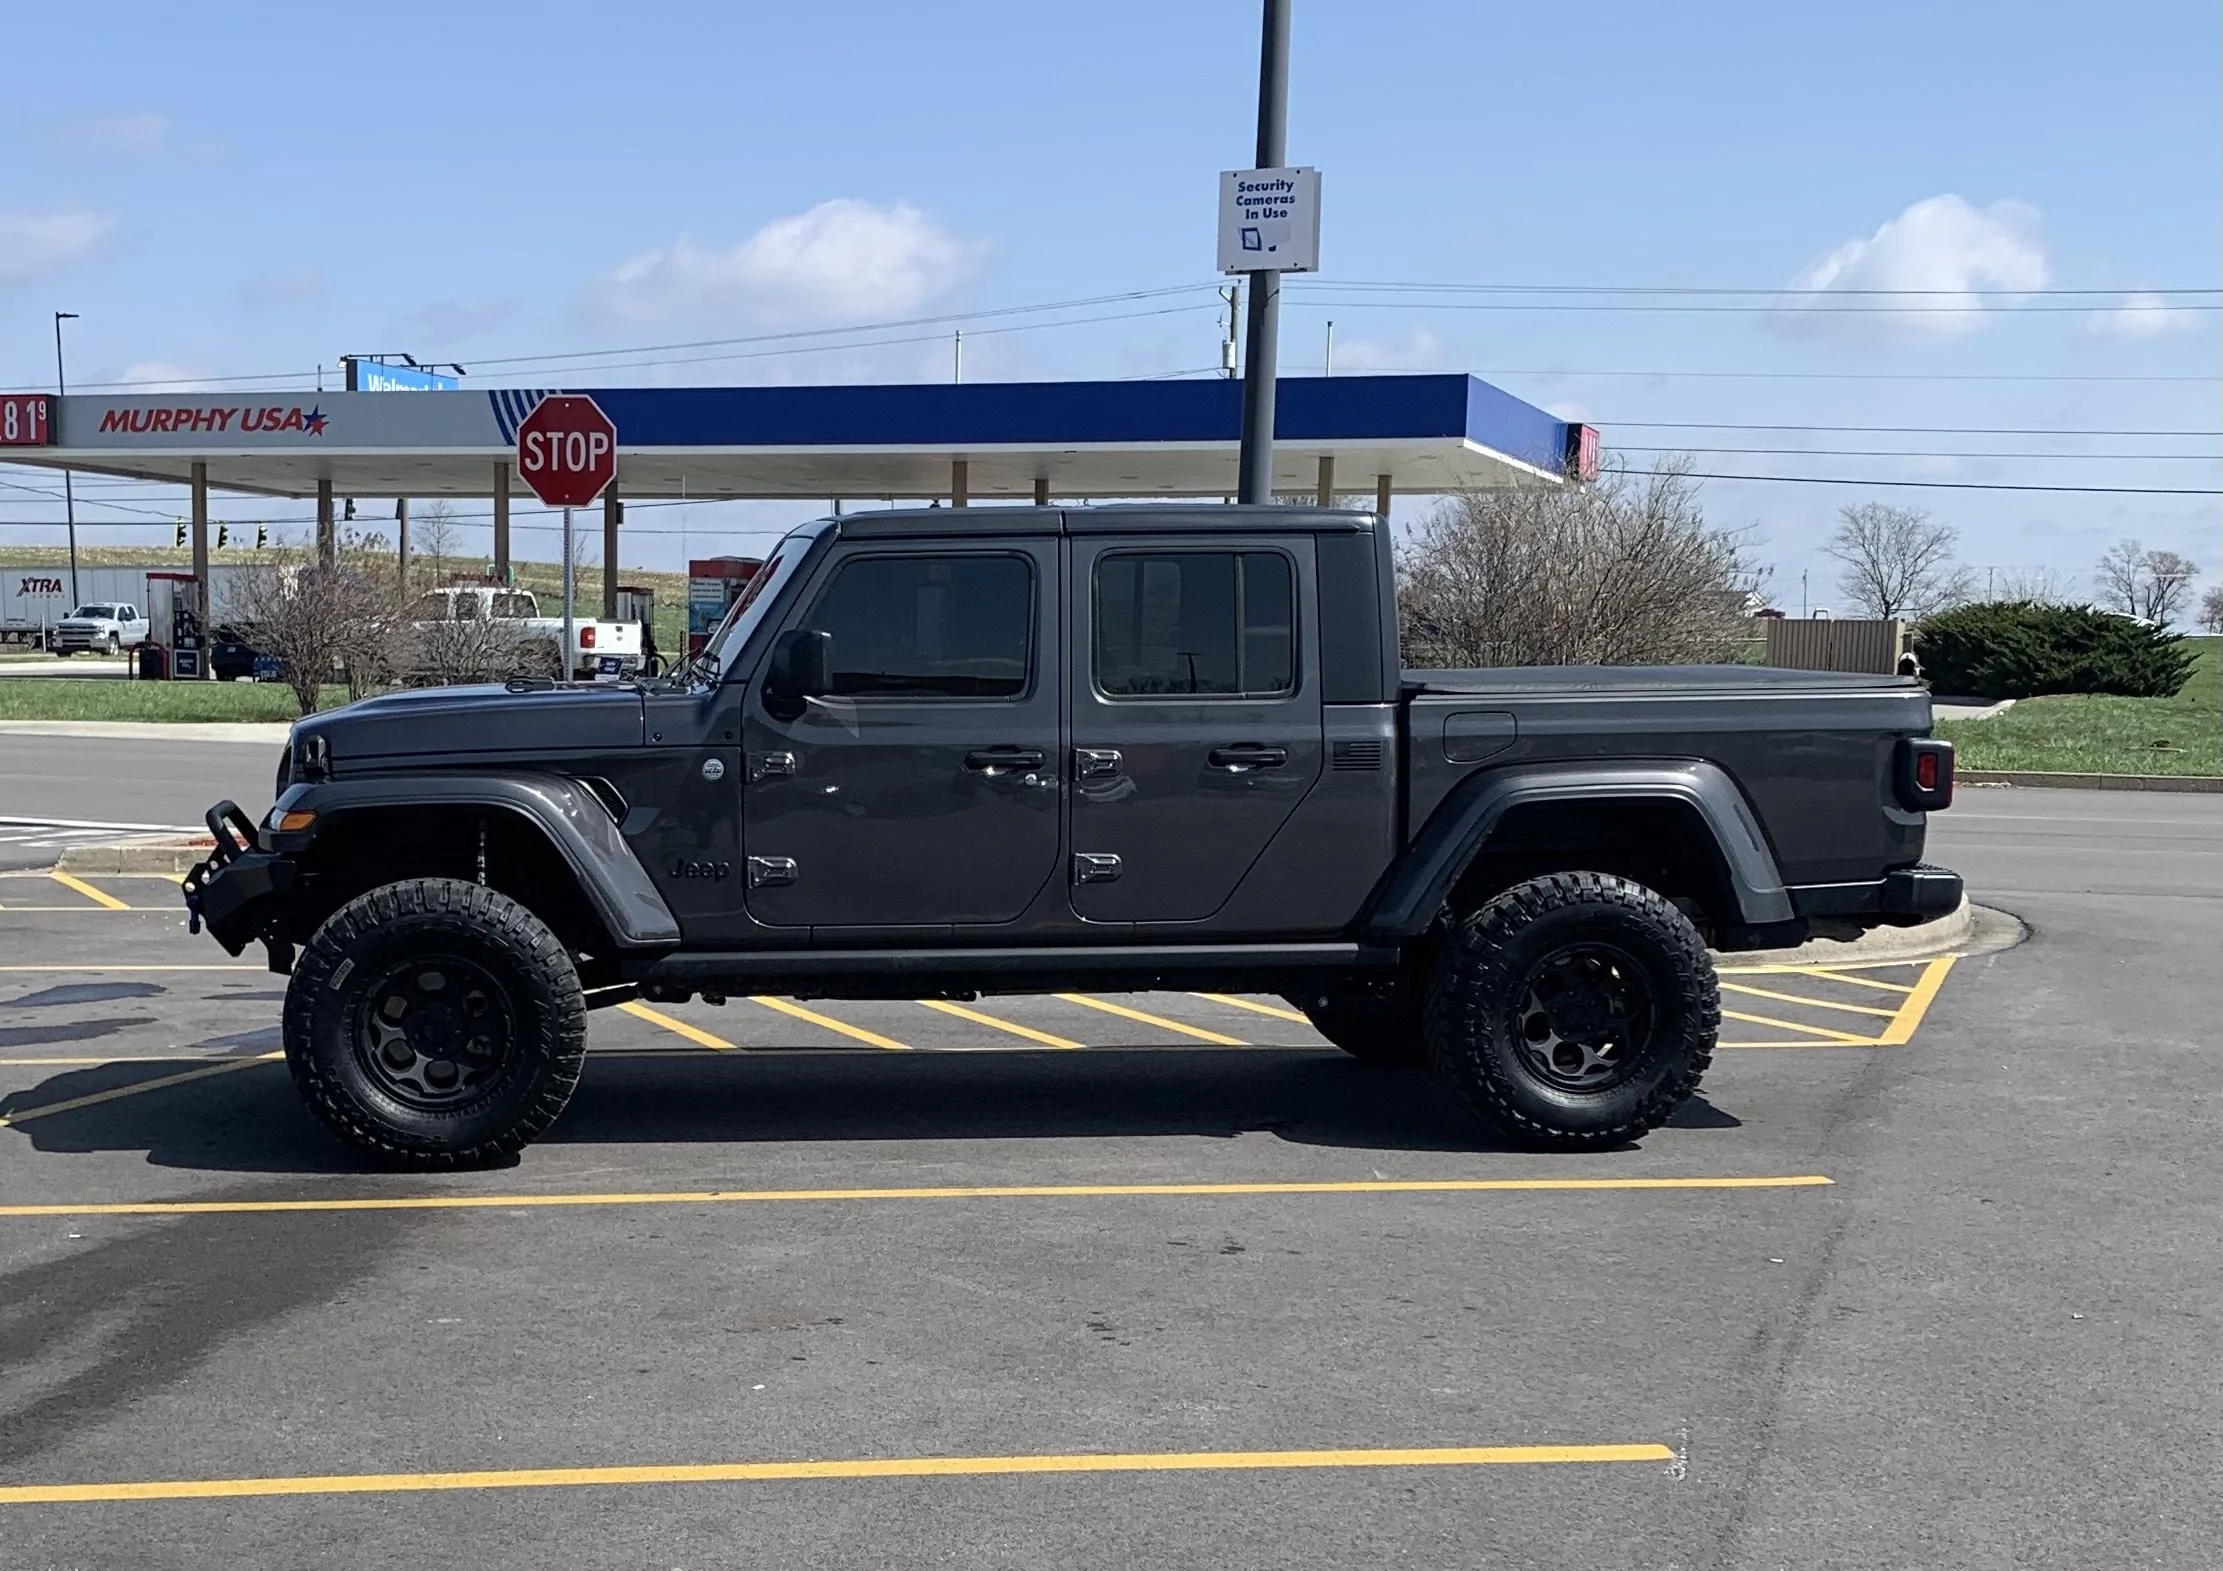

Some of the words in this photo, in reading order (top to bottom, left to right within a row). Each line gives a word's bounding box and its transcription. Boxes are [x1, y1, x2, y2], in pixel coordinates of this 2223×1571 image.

[1238, 179, 1294, 193] Security
[1236, 195, 1295, 206] Cameras
[1245, 209, 1258, 219] In
[1263, 208, 1288, 219] Use
[99, 408, 238, 432] MURPHY
[241, 407, 303, 431] USA
[524, 431, 609, 471] STOP
[16, 577, 62, 597] XTRA
[669, 858, 729, 881] Jeep
